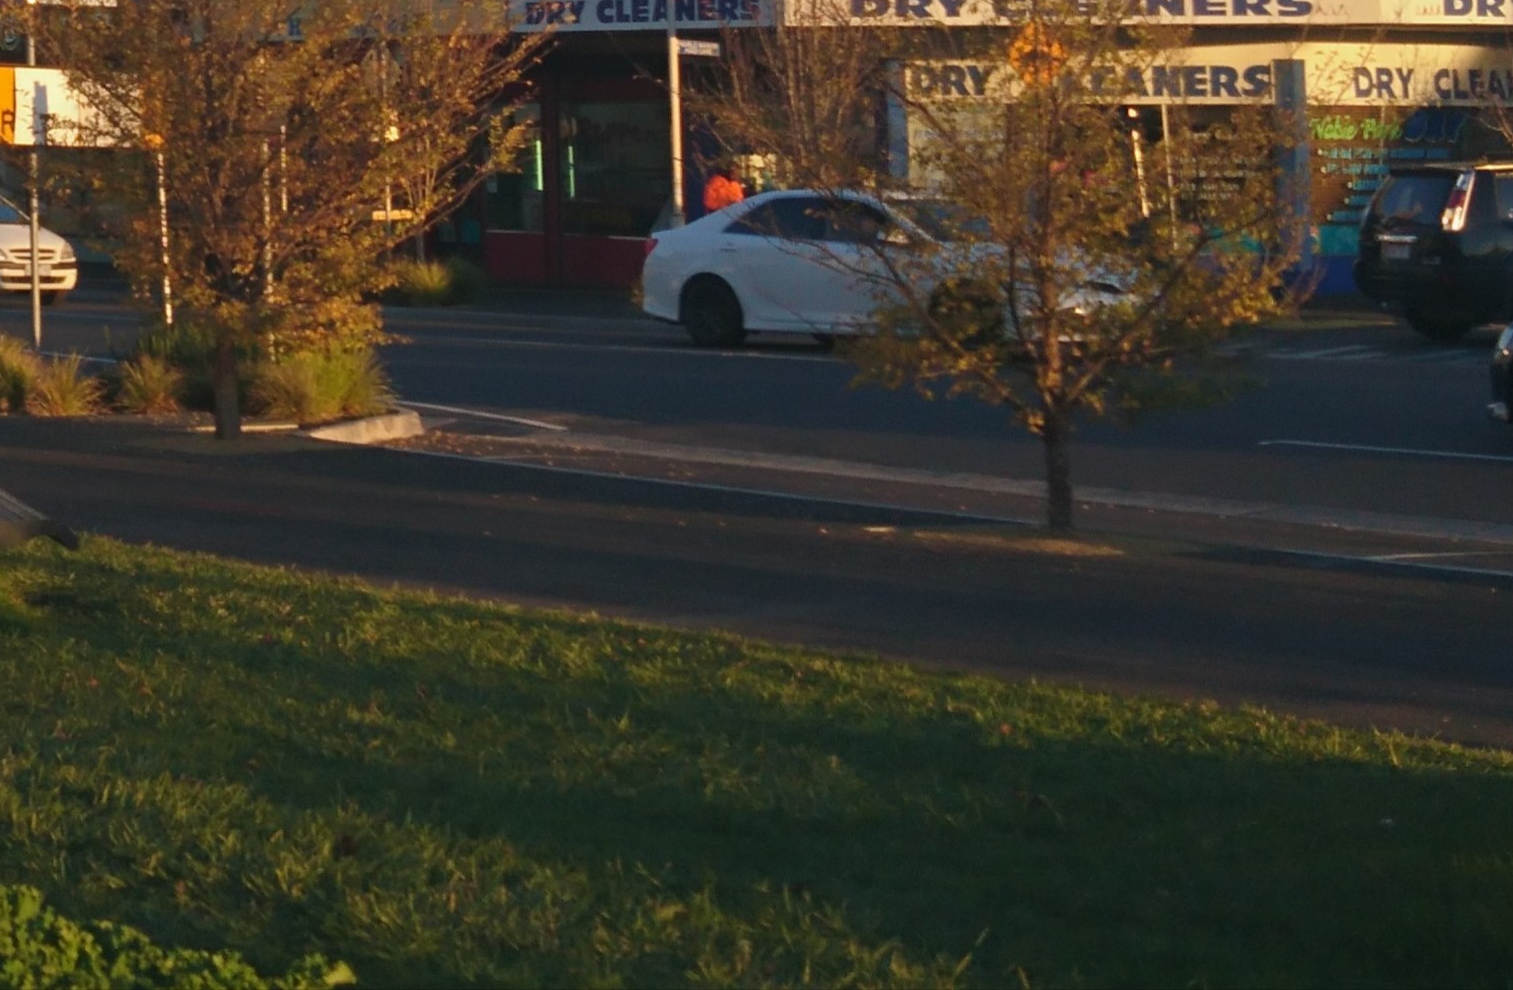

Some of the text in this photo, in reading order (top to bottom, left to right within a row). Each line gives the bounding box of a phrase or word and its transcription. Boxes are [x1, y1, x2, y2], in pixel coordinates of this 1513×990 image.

[525, 1, 584, 25] DRY
[911, 64, 1274, 98] DRY EANERS
[1354, 66, 1513, 101] DRY CLEA
